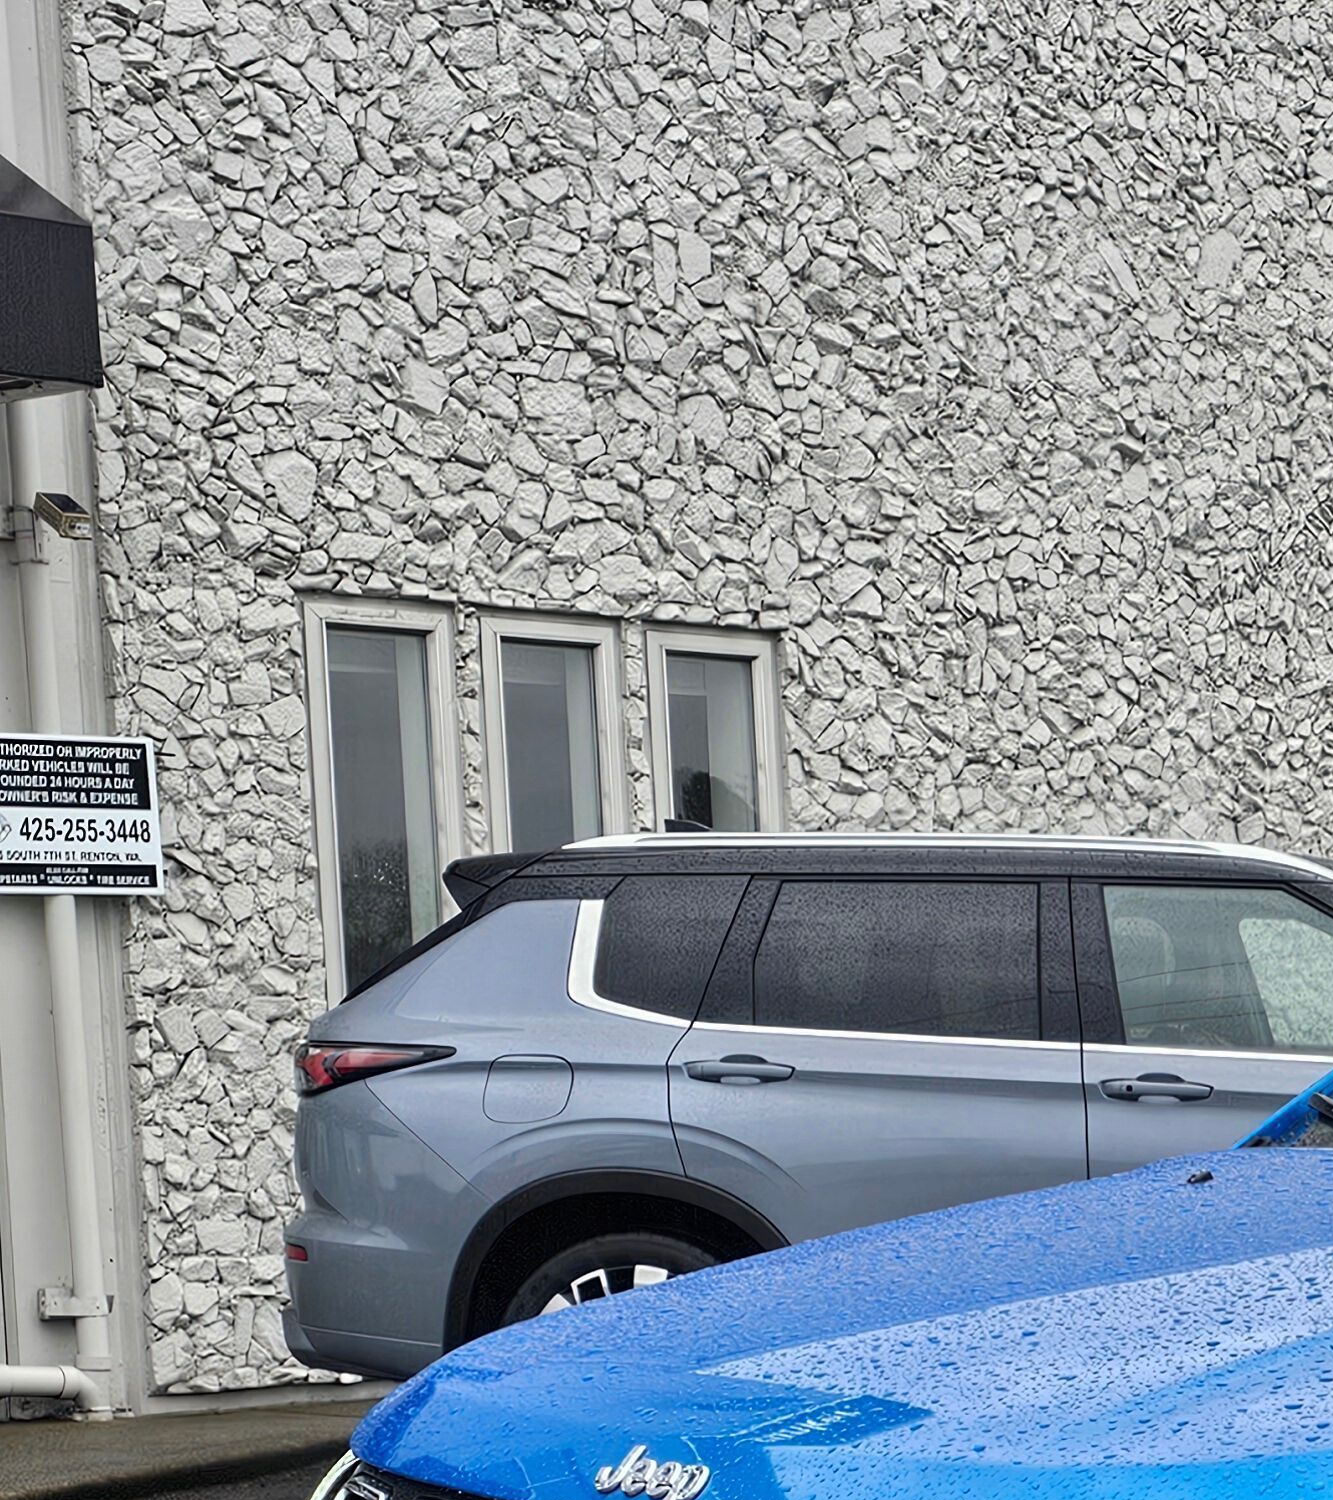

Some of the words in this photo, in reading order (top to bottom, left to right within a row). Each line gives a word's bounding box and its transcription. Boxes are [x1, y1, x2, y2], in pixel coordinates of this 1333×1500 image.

[75, 746, 142, 760] IMPROPERLY
[32, 760, 85, 773] VEHICLES
[87, 762, 113, 774] WILL
[64, 777, 102, 789] HOURS
[103, 778, 113, 789] A
[114, 778, 135, 789] DAY
[51, 791, 77, 803] RISK
[90, 792, 138, 805] EXPENSE
[20, 817, 151, 844] 425-255-3448
[6, 850, 41, 861] SOUTH
[44, 851, 62, 861] 7TH
